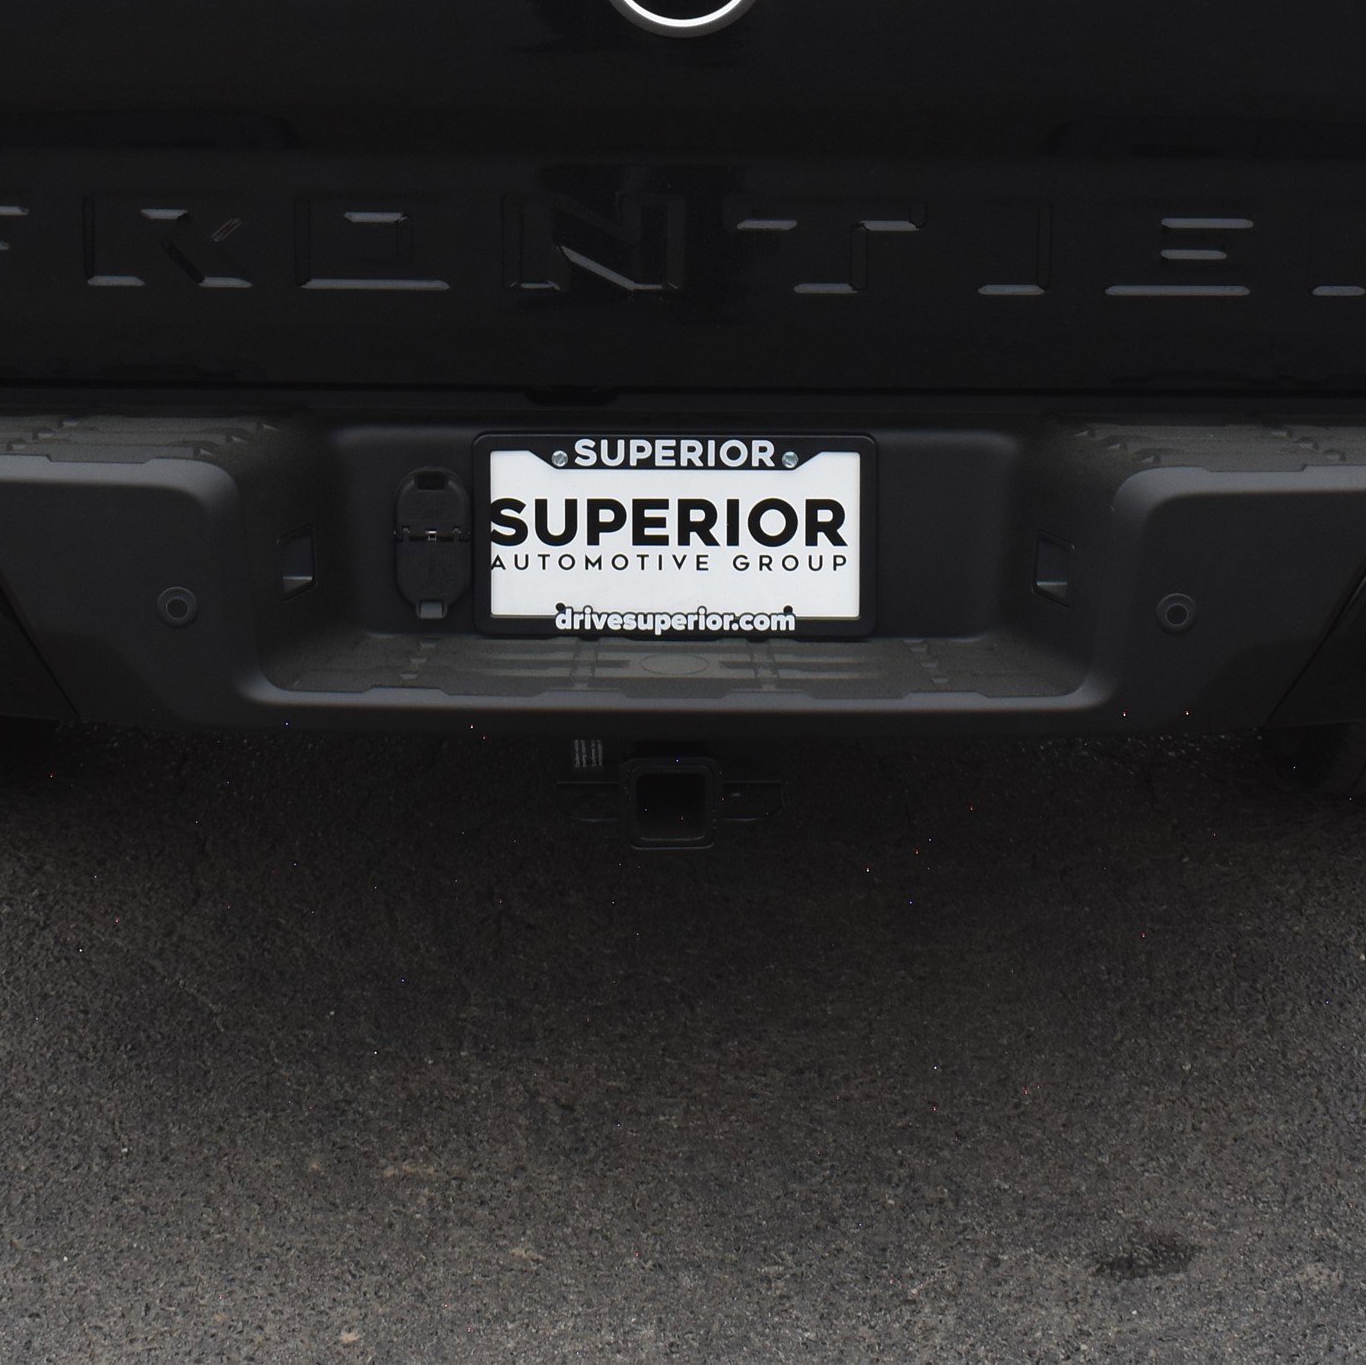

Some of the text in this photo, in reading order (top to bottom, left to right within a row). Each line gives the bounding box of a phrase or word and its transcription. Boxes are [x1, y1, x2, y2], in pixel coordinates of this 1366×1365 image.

[574, 438, 775, 467] SUPERIOR
[491, 497, 848, 547] SUPERIOR
[491, 554, 848, 572] AUTOMOTIVE GROUP
[555, 605, 795, 636] drivesuperior.com
